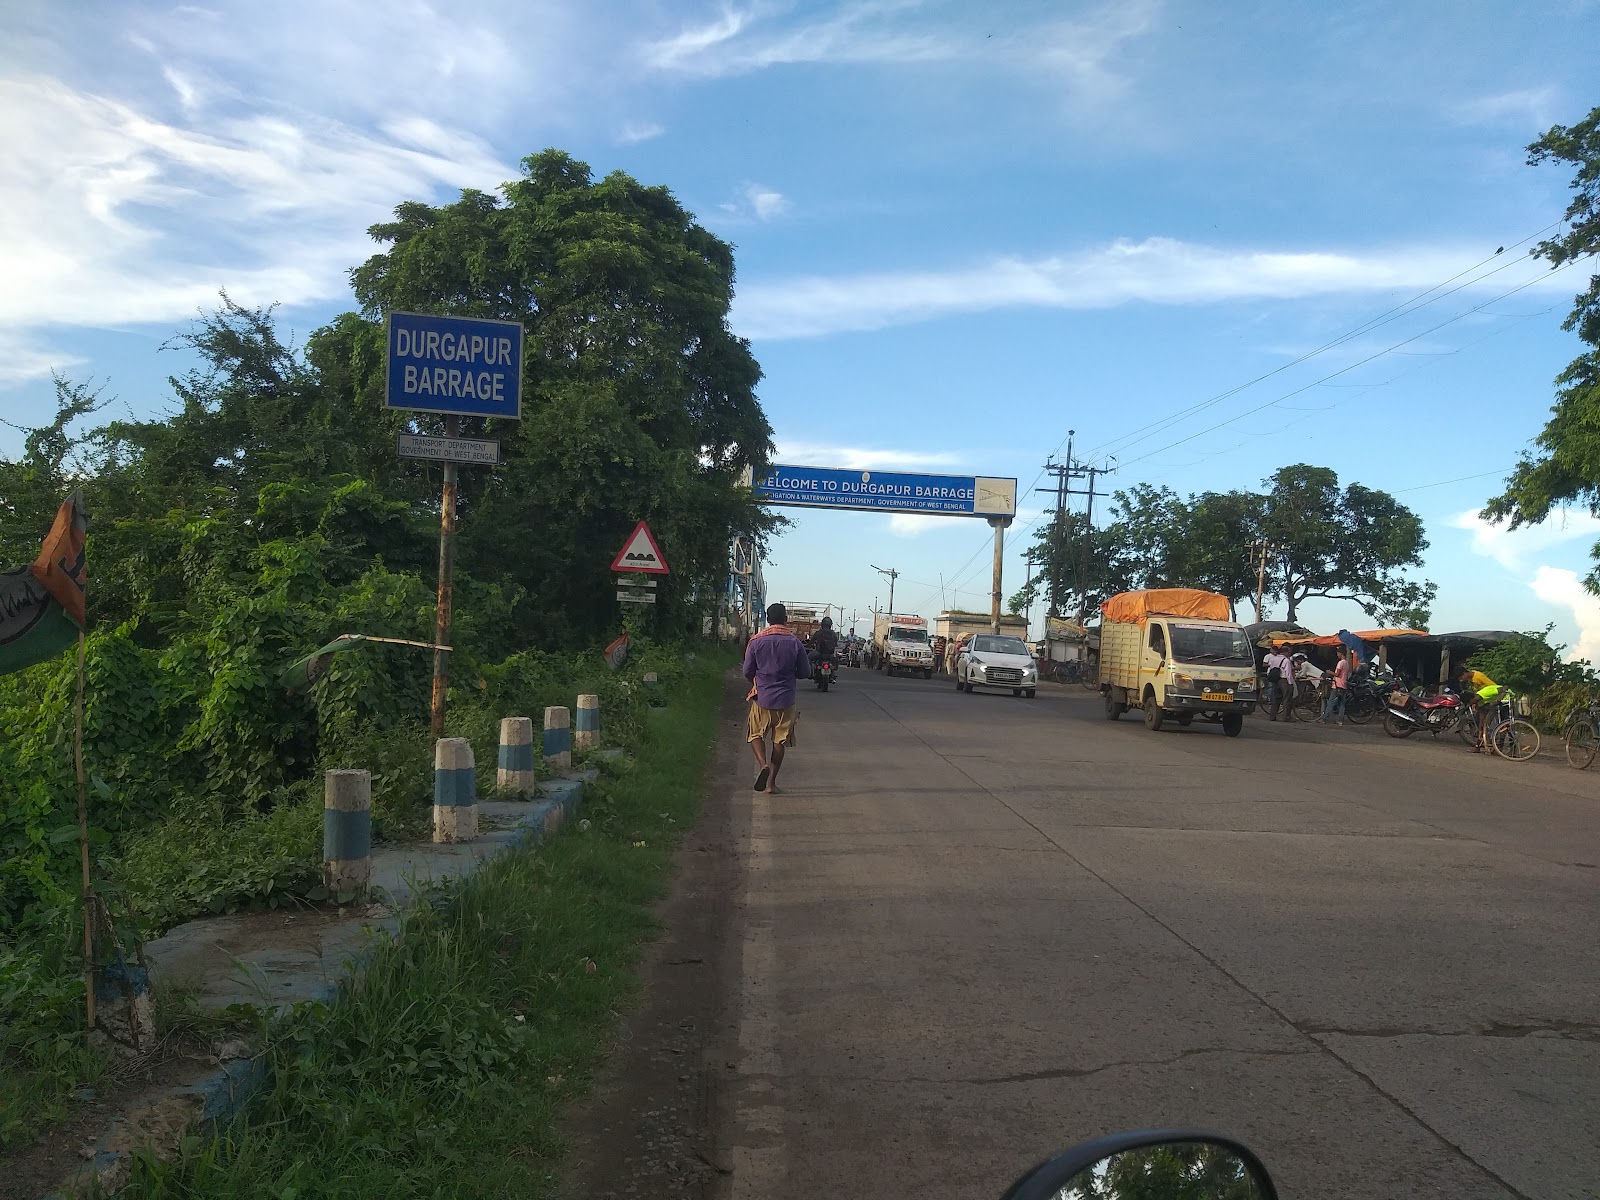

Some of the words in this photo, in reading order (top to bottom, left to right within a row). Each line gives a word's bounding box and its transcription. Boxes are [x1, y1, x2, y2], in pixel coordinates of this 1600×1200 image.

[396, 328, 512, 366] DURGAPUR
[404, 365, 505, 401] BARRAGE
[412, 438, 446, 447] TRANSPORT
[449, 441, 487, 451] DEPARTMENT
[400, 446, 441, 456] GOVERNMENT
[443, 449, 452, 457] OF
[453, 450, 471, 459] WEST
[472, 452, 496, 461] BENGAL
[821, 480, 838, 491] TO
[842, 482, 911, 495] DURGAPUR
[915, 486, 974, 499] BARRAGE
[801, 494, 836, 503] WATERWAYS
[926, 501, 943, 509] WEST
[943, 502, 966, 510] BENGAL
